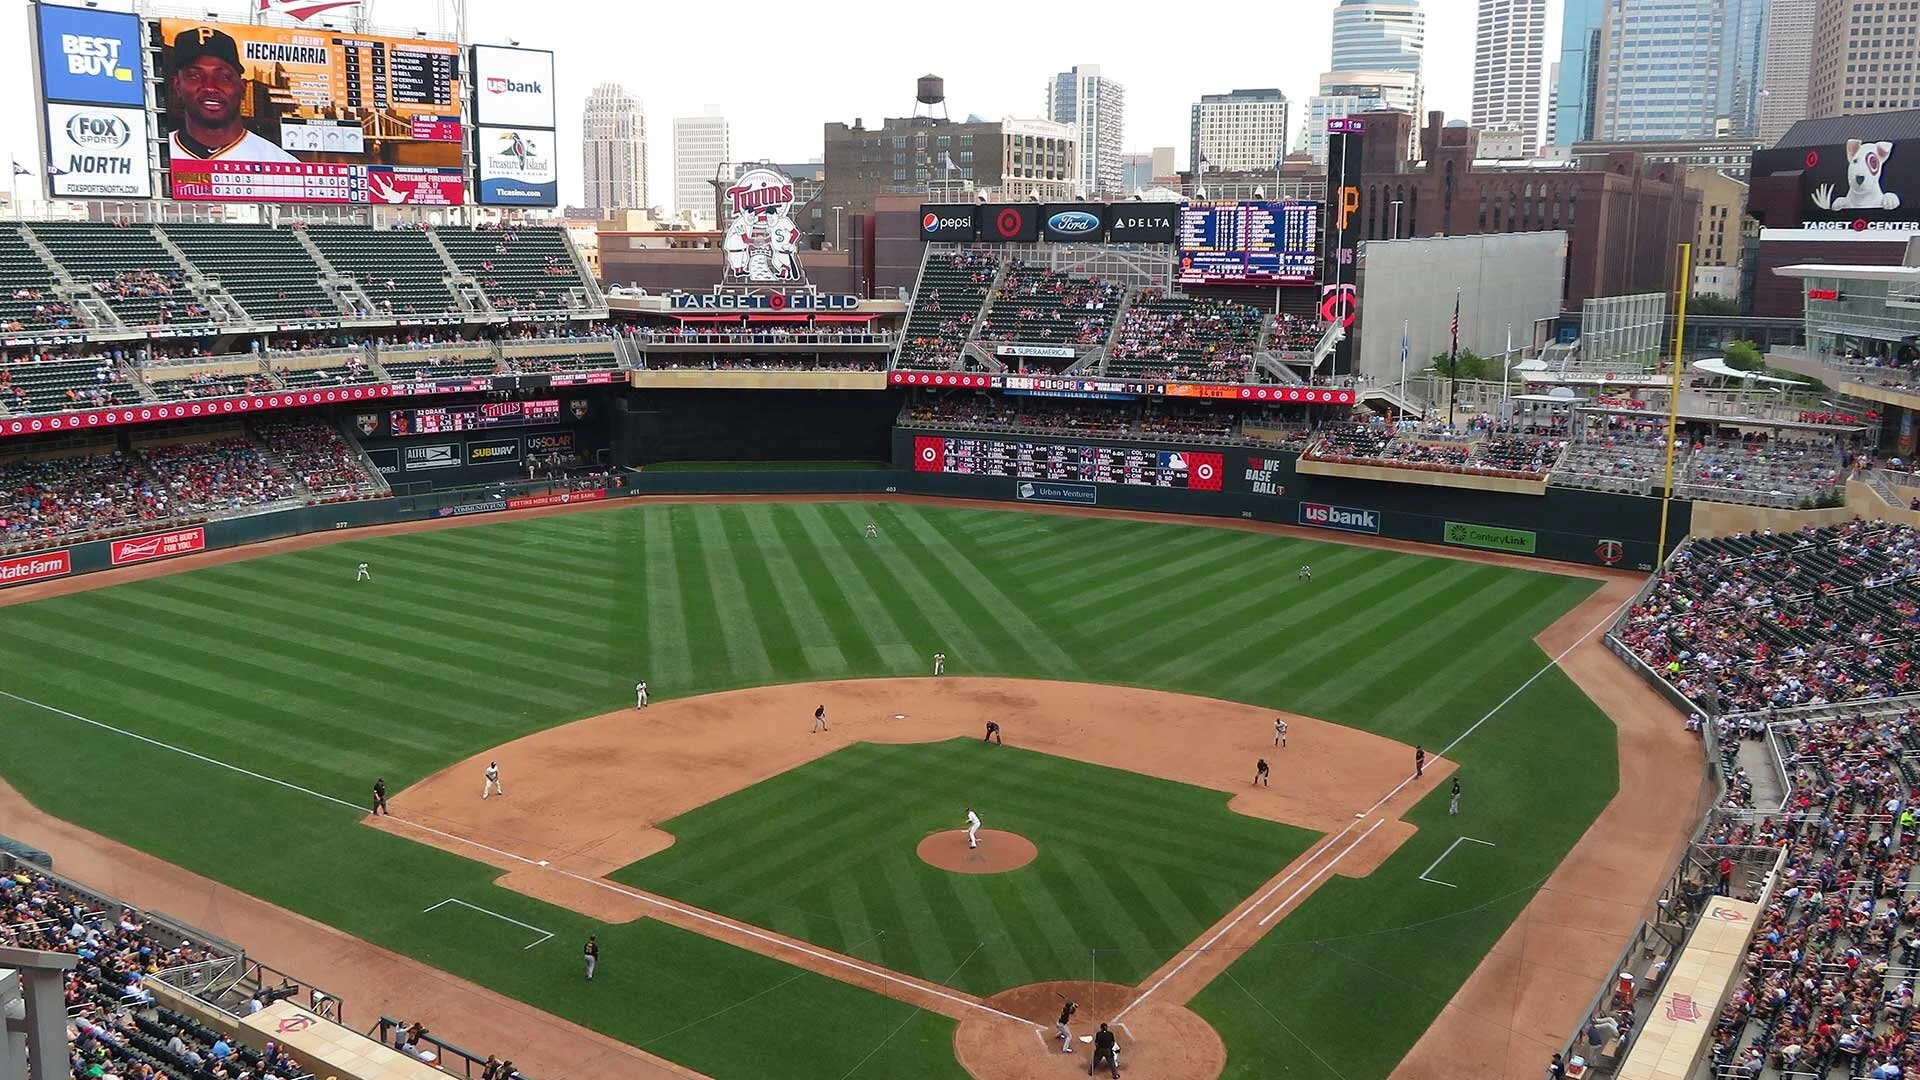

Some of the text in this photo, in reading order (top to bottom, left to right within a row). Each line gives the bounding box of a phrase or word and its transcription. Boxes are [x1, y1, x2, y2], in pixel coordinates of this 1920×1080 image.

[62, 33, 122, 59] BEST
[246, 43, 327, 65] HECHAVARRIA
[68, 55, 118, 77] BUY
[79, 117, 116, 137] FOX
[80, 136, 119, 144] SPORTS
[69, 154, 130, 174] NORTH
[487, 157, 547, 171] Treasure Island
[350, 167, 355, 175] B
[350, 180, 357, 188] S
[428, 175, 462, 183] FIREWORKS
[726, 182, 792, 216] Twins
[940, 216, 971, 230] pepsi
[1058, 215, 1088, 231] Ford
[1128, 217, 1169, 228] DELTA
[1802, 221, 1918, 230] TARGET CENTER
[775, 229, 784, 243] S
[672, 294, 858, 310] TARGET FIELD
[1017, 348, 1067, 356] SUPERAMERICA
[481, 403, 520, 417] Twins
[407, 448, 426, 459] ALTEC
[471, 446, 515, 457] SUBWAY
[1264, 459, 1280, 471] WE
[1245, 469, 1271, 482] BASE
[1040, 488, 1061, 496] Urban
[1062, 489, 1094, 498] Ventures
[1253, 481, 1276, 494] BALL
[533, 497, 548, 505] MORE
[580, 492, 596, 500] GAME.
[454, 504, 489, 513] COMMUNITY
[489, 502, 506, 510] FUND
[163, 532, 199, 545] THIS BUD'S
[1470, 531, 1526, 546] CenturyLink
[125, 544, 156, 554] Budweiser
[163, 541, 192, 552] FOR YOU.
